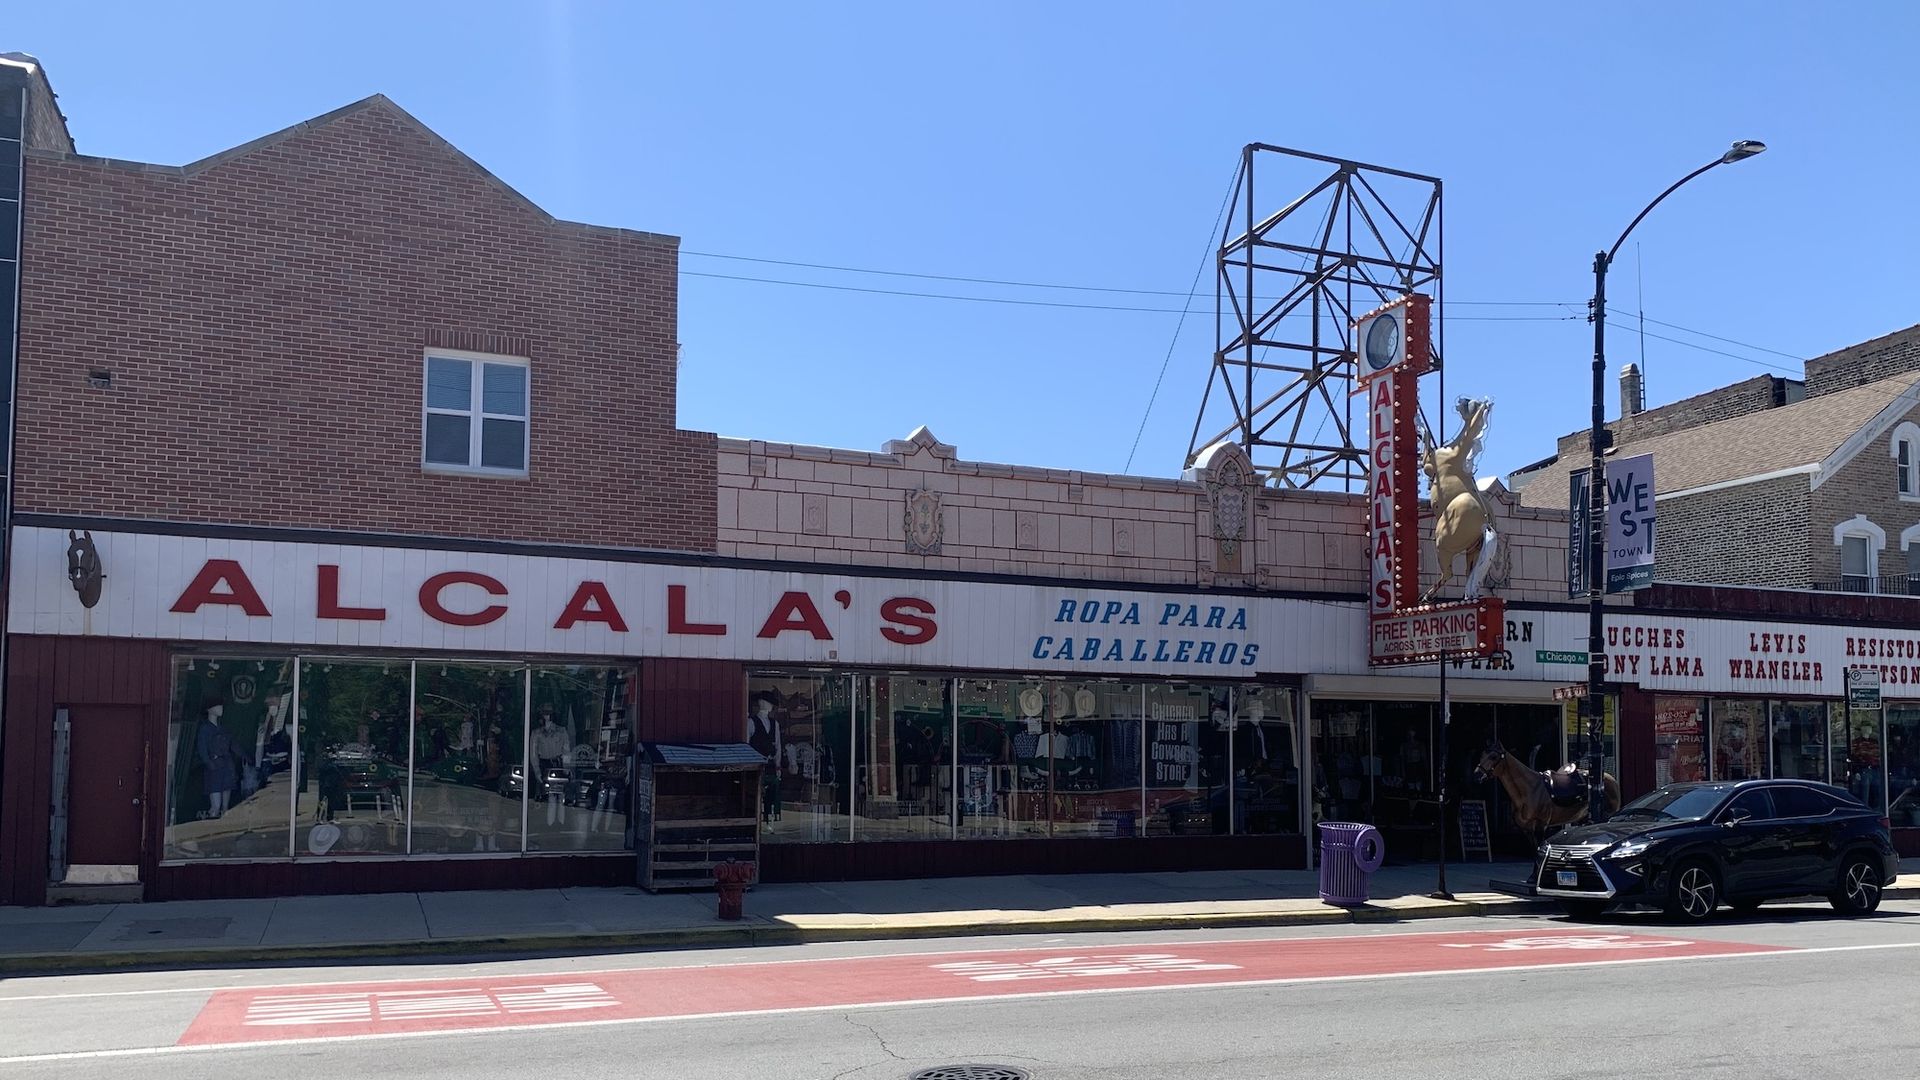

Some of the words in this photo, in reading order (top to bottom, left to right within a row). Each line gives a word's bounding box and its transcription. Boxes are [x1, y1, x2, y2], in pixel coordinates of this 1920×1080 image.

[1374, 382, 1392, 609] ALCALA'S
[1608, 472, 1656, 554] WEST
[1613, 547, 1643, 559] TOWN
[1611, 574, 1625, 583] Epic
[1626, 571, 1649, 581] Spices
[170, 559, 937, 645] ALCALA'S
[1054, 600, 1140, 626] ROPA
[1159, 602, 1249, 631] PARA
[1375, 621, 1408, 641] FREE
[1413, 613, 1476, 637] PARKING
[1607, 626, 1686, 648] UCCHES
[1032, 636, 1260, 666] CABALLEROS
[1384, 641, 1415, 653] ACROSS
[1417, 639, 1433, 650] THE
[1434, 635, 1467, 648] STREET
[1750, 632, 1806, 653] LEVIS
[1846, 637, 1920, 659] RESISTO
[1546, 652, 1576, 664] Chicago
[1603, 654, 1640, 675] ONY
[1650, 655, 1704, 677] LAMA
[1729, 659, 1823, 681] WRANGLER
[1152, 702, 1194, 721] CHICAGO
[1157, 721, 1177, 741] HAS
[1181, 722, 1188, 741] A
[1677, 735, 1705, 743] ARIAT
[1156, 762, 1187, 781] STORE
